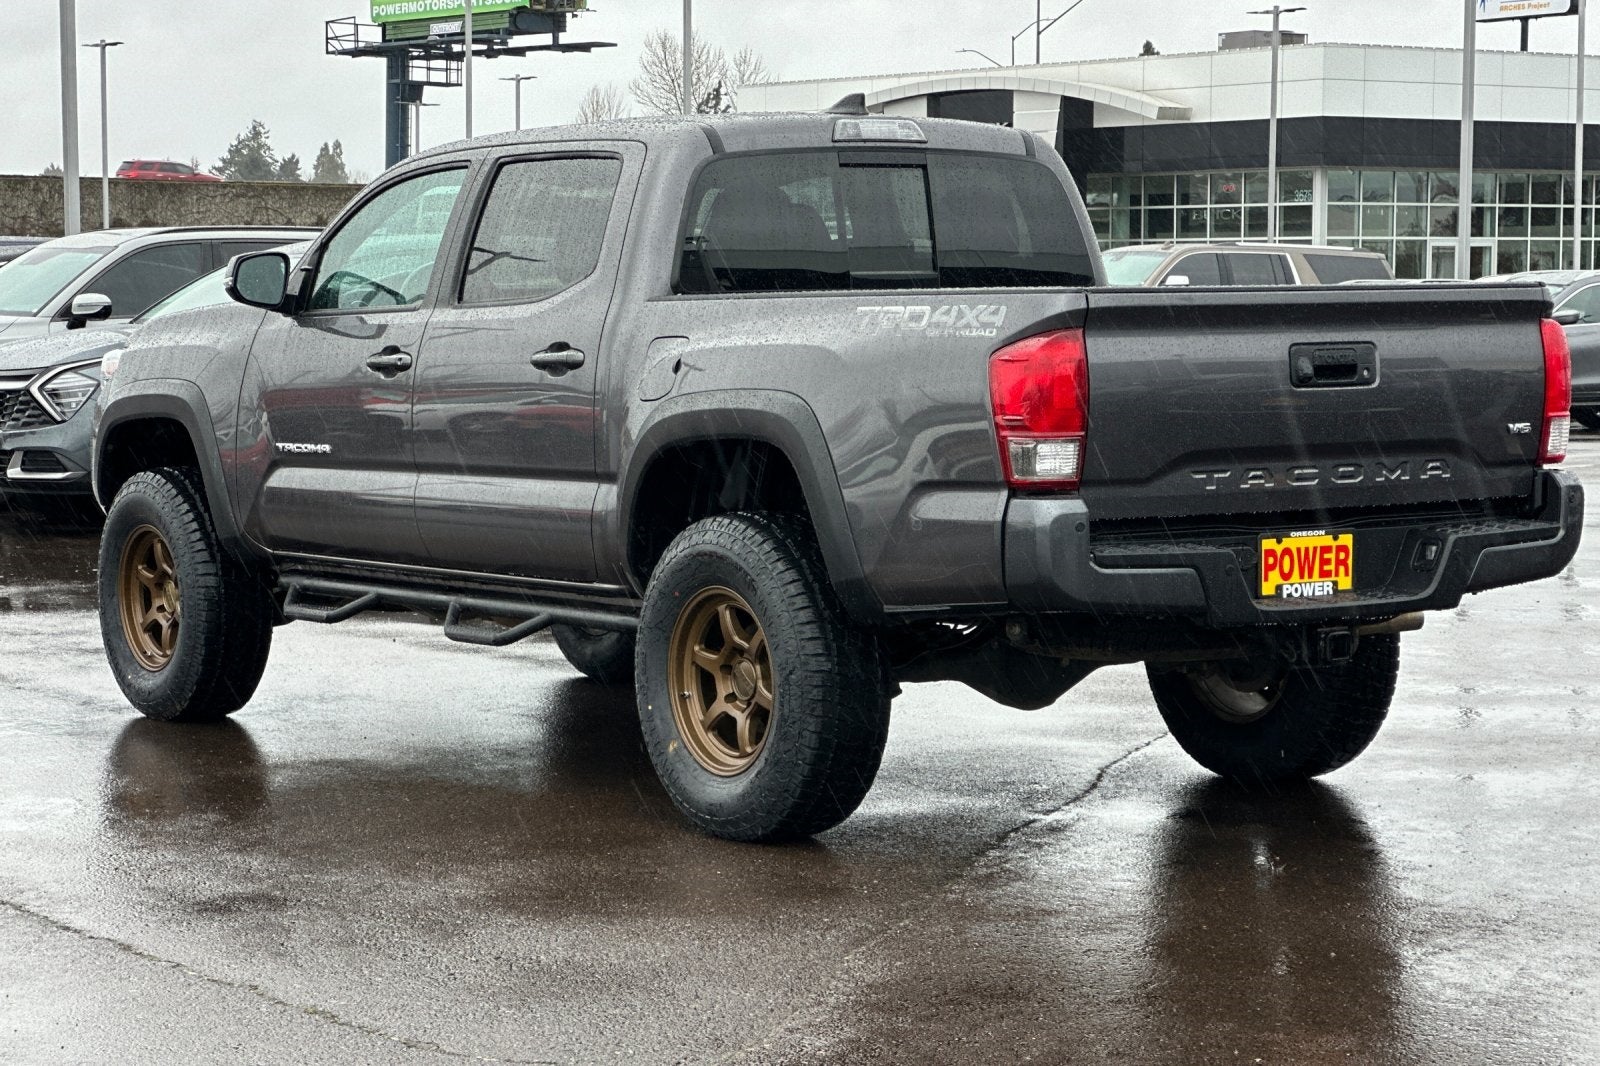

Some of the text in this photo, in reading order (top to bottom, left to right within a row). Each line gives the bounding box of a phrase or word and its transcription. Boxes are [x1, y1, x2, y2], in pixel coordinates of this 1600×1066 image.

[372, 0, 521, 17] POWERMOTORSPRTS.
[1500, 2, 1550, 12] ARCHES Project
[1294, 189, 1313, 202] 3675
[856, 305, 931, 332] TRD
[1508, 422, 1531, 434] V6
[275, 442, 332, 454] TACOMA
[1191, 459, 1451, 490] TACOMA
[1290, 529, 1326, 538] OREGON
[1263, 544, 1350, 583] POWER
[1282, 581, 1334, 599] POWER
